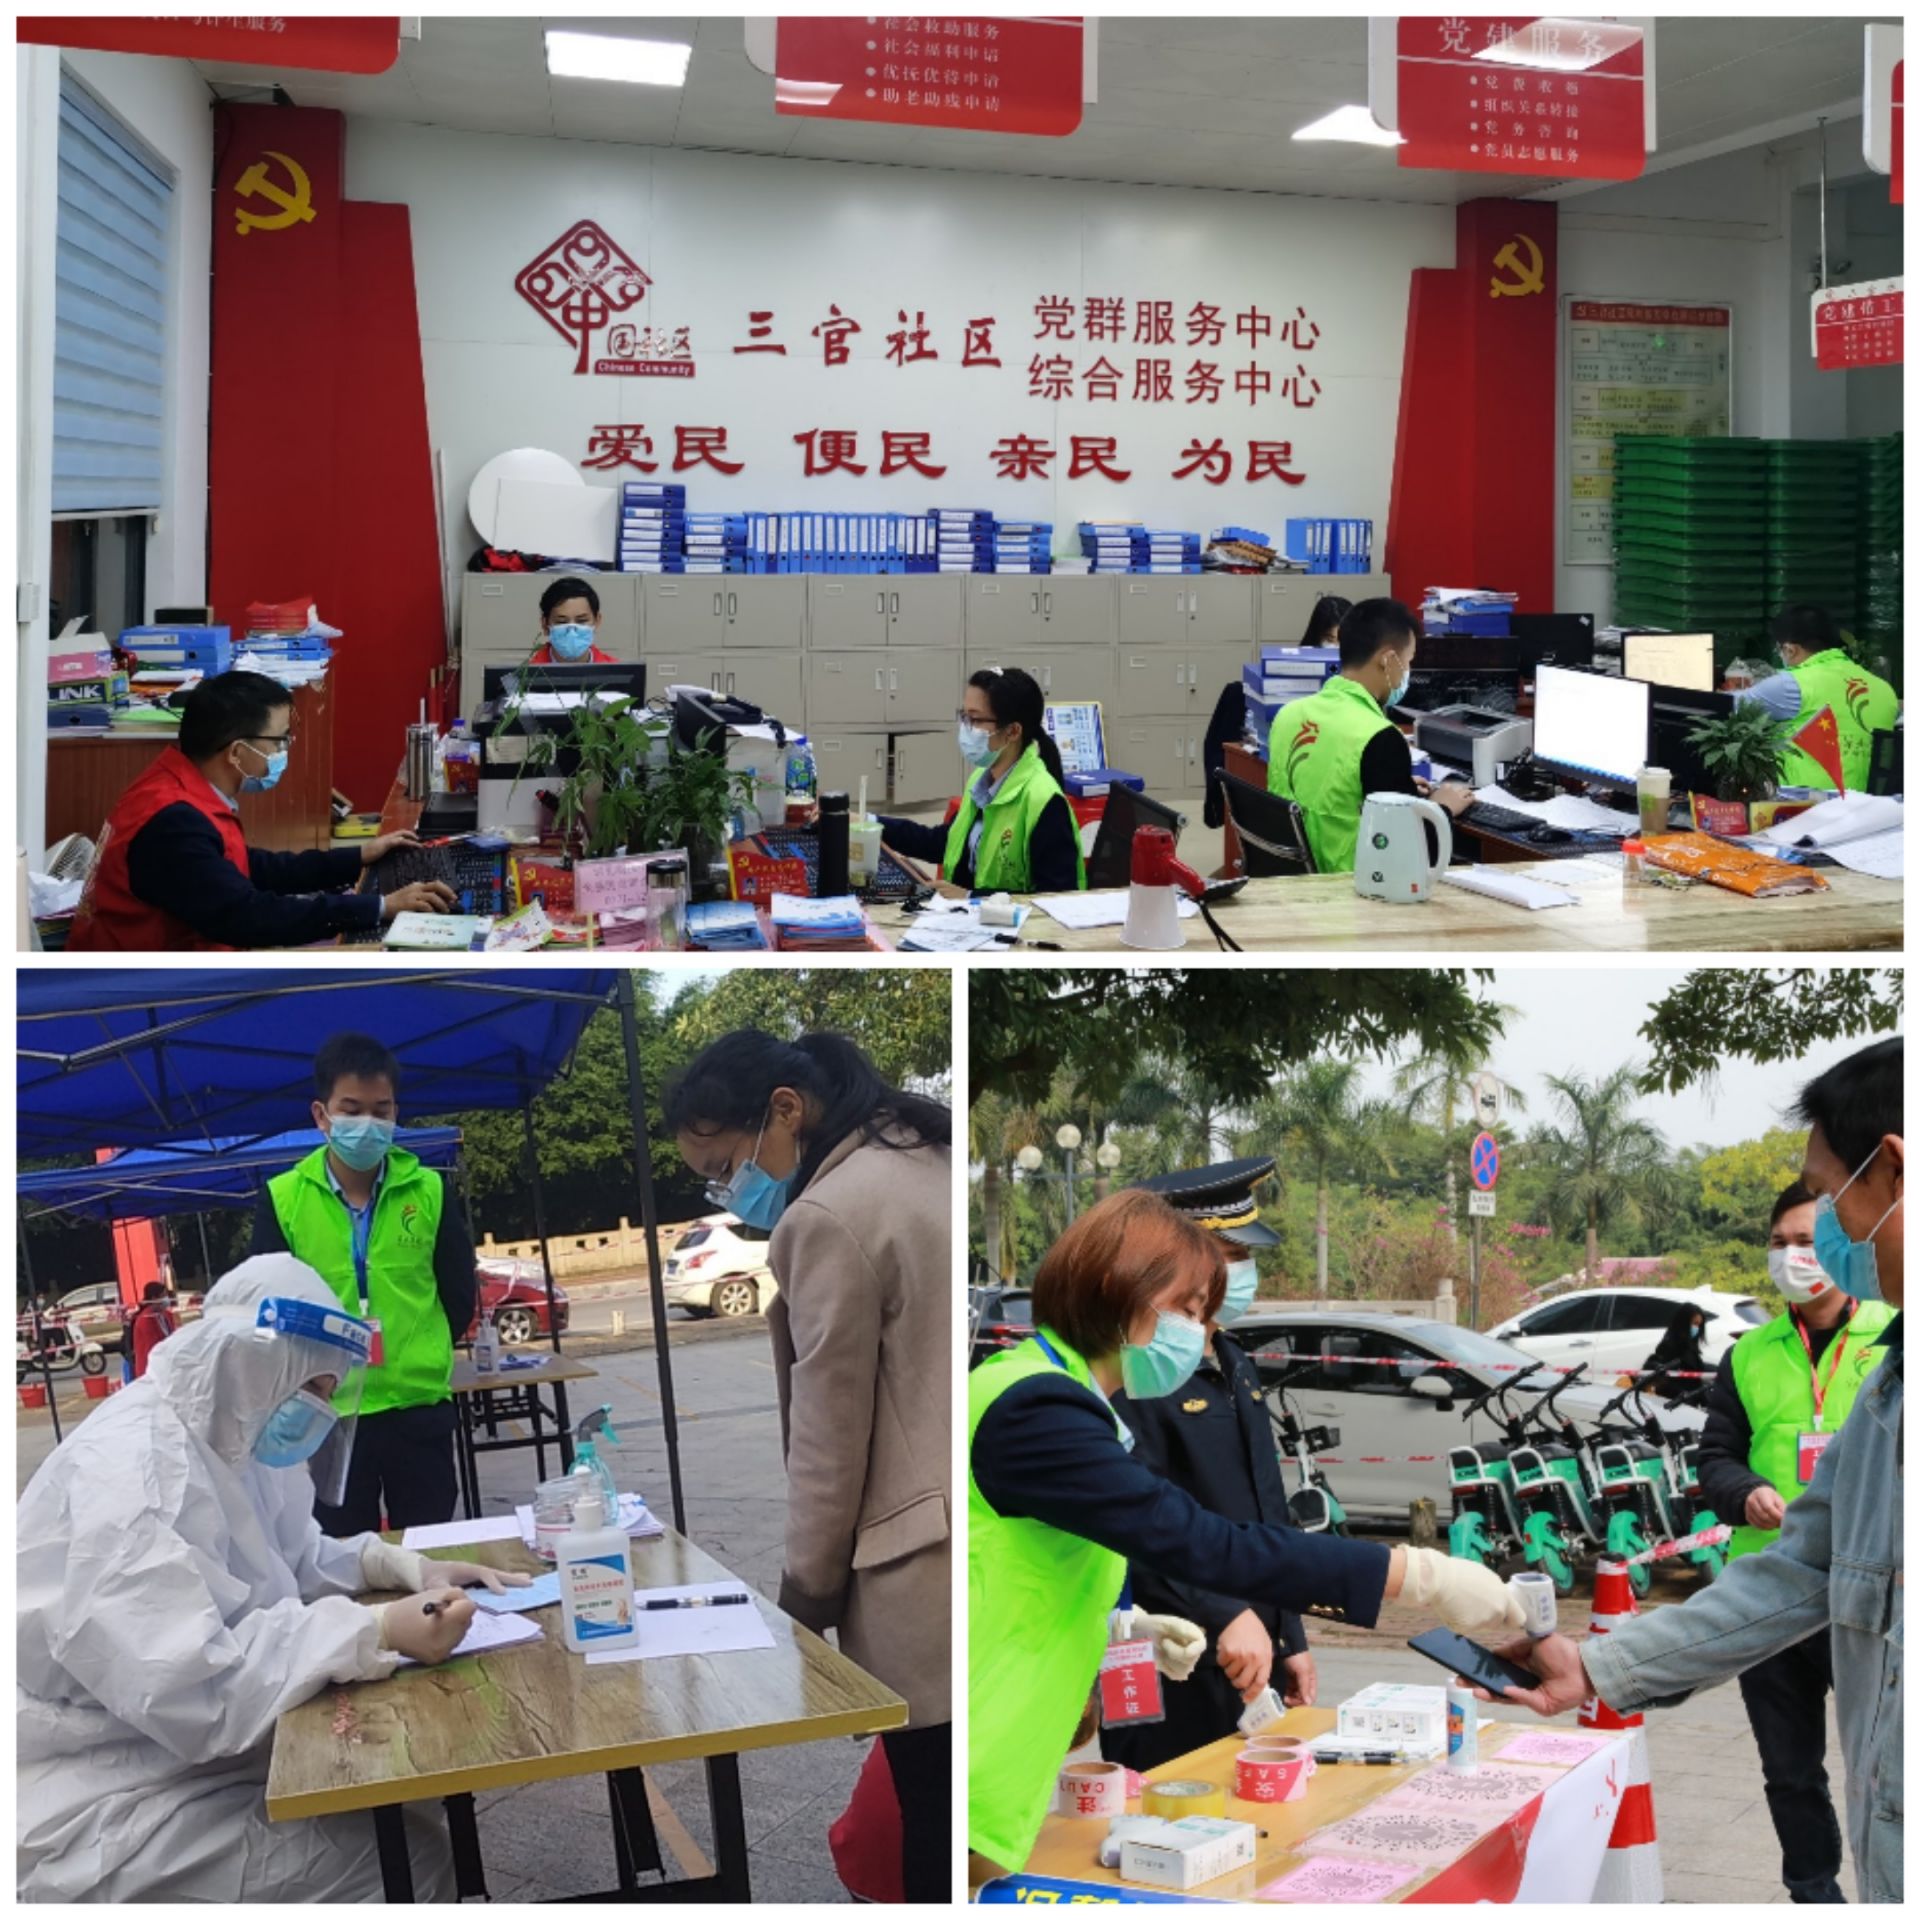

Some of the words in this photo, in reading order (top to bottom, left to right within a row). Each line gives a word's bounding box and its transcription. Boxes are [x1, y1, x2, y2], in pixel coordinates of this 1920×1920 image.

[884, 38, 999, 63] 社会福利申请
[1438, 17, 1606, 58] 党建服务
[883, 63, 1000, 88] 优抚优待申请
[883, 88, 1000, 112] 助老助残申请
[1484, 98, 1579, 119] 组织关系转接
[1484, 119, 1578, 141] 党务咨询
[1484, 142, 1579, 163] 党员志愿服务
[733, 303, 1002, 368] 三官社区
[1033, 294, 1321, 351] 党群服务中心
[1027, 352, 1322, 408] 综合服务中心
[580, 423, 745, 476] 爱民
[792, 427, 948, 478] 便民
[989, 432, 1133, 482] 亲民
[1171, 437, 1307, 486] 为民
[1121, 1669, 1141, 1714] 工作证
